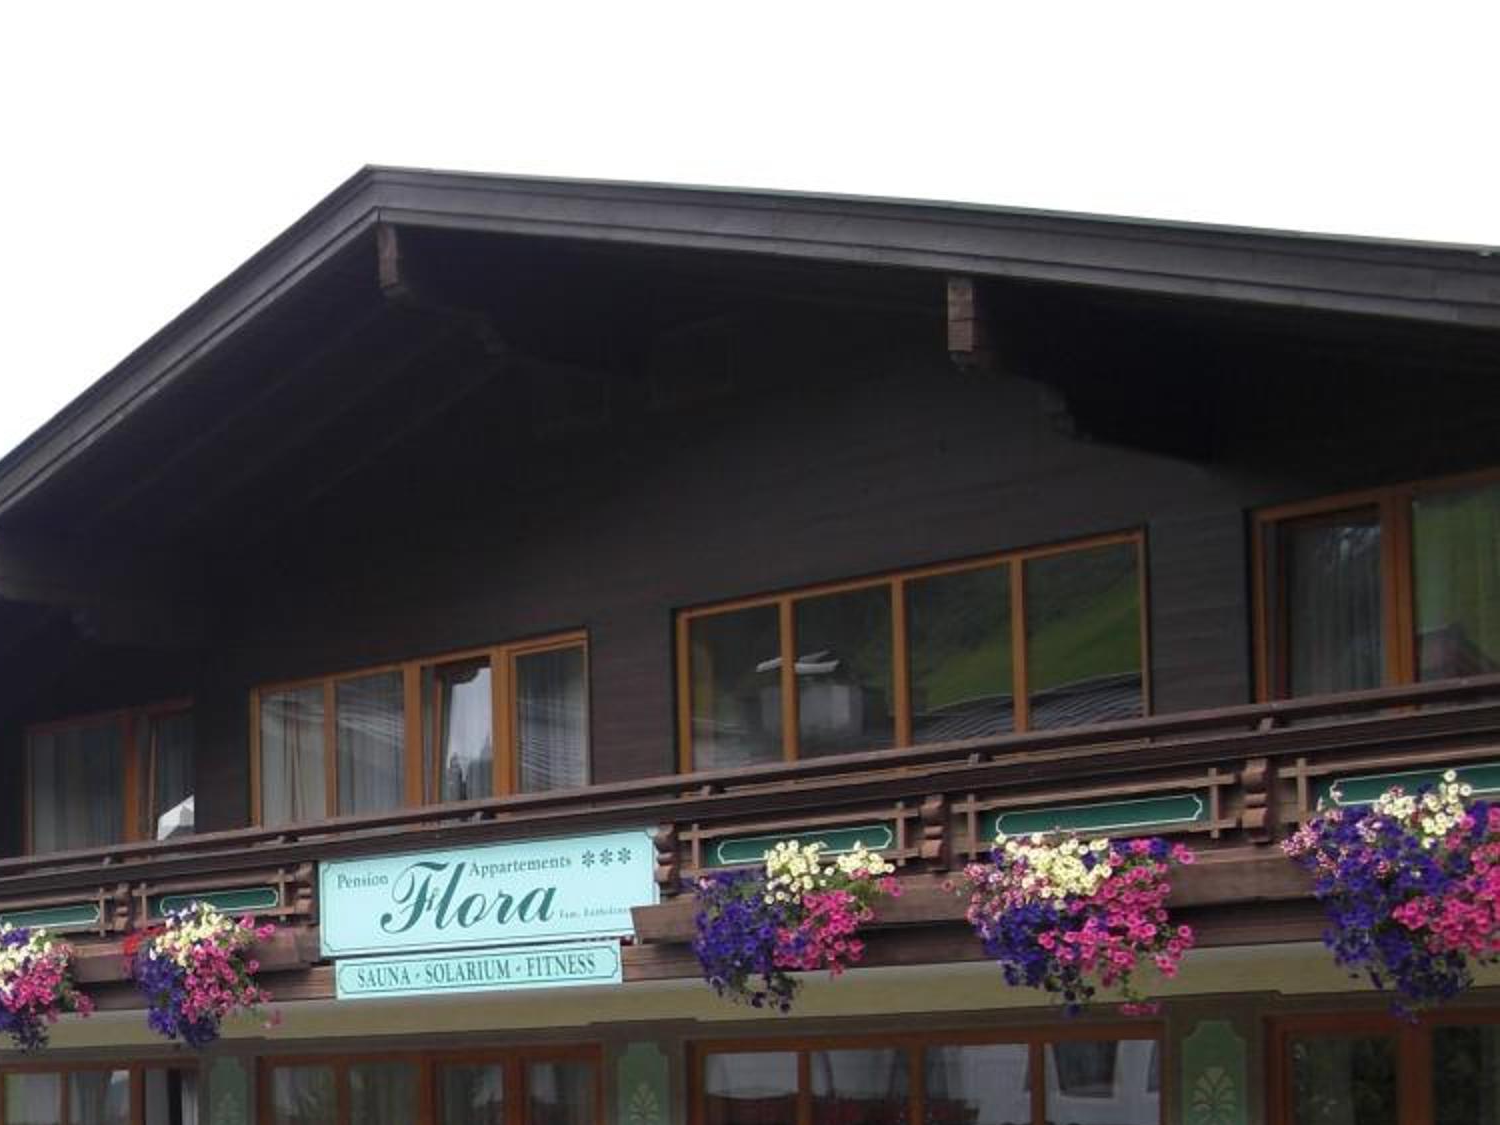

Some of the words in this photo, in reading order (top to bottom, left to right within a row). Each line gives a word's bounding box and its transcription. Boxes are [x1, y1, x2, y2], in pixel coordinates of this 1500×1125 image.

[337, 872, 389, 889] Pension
[469, 856, 572, 878] Appartements
[380, 862, 556, 934] Flora
[357, 966, 411, 988] SAUNA
[425, 959, 511, 983] SOLARIUM
[526, 953, 596, 976] FITNESS
